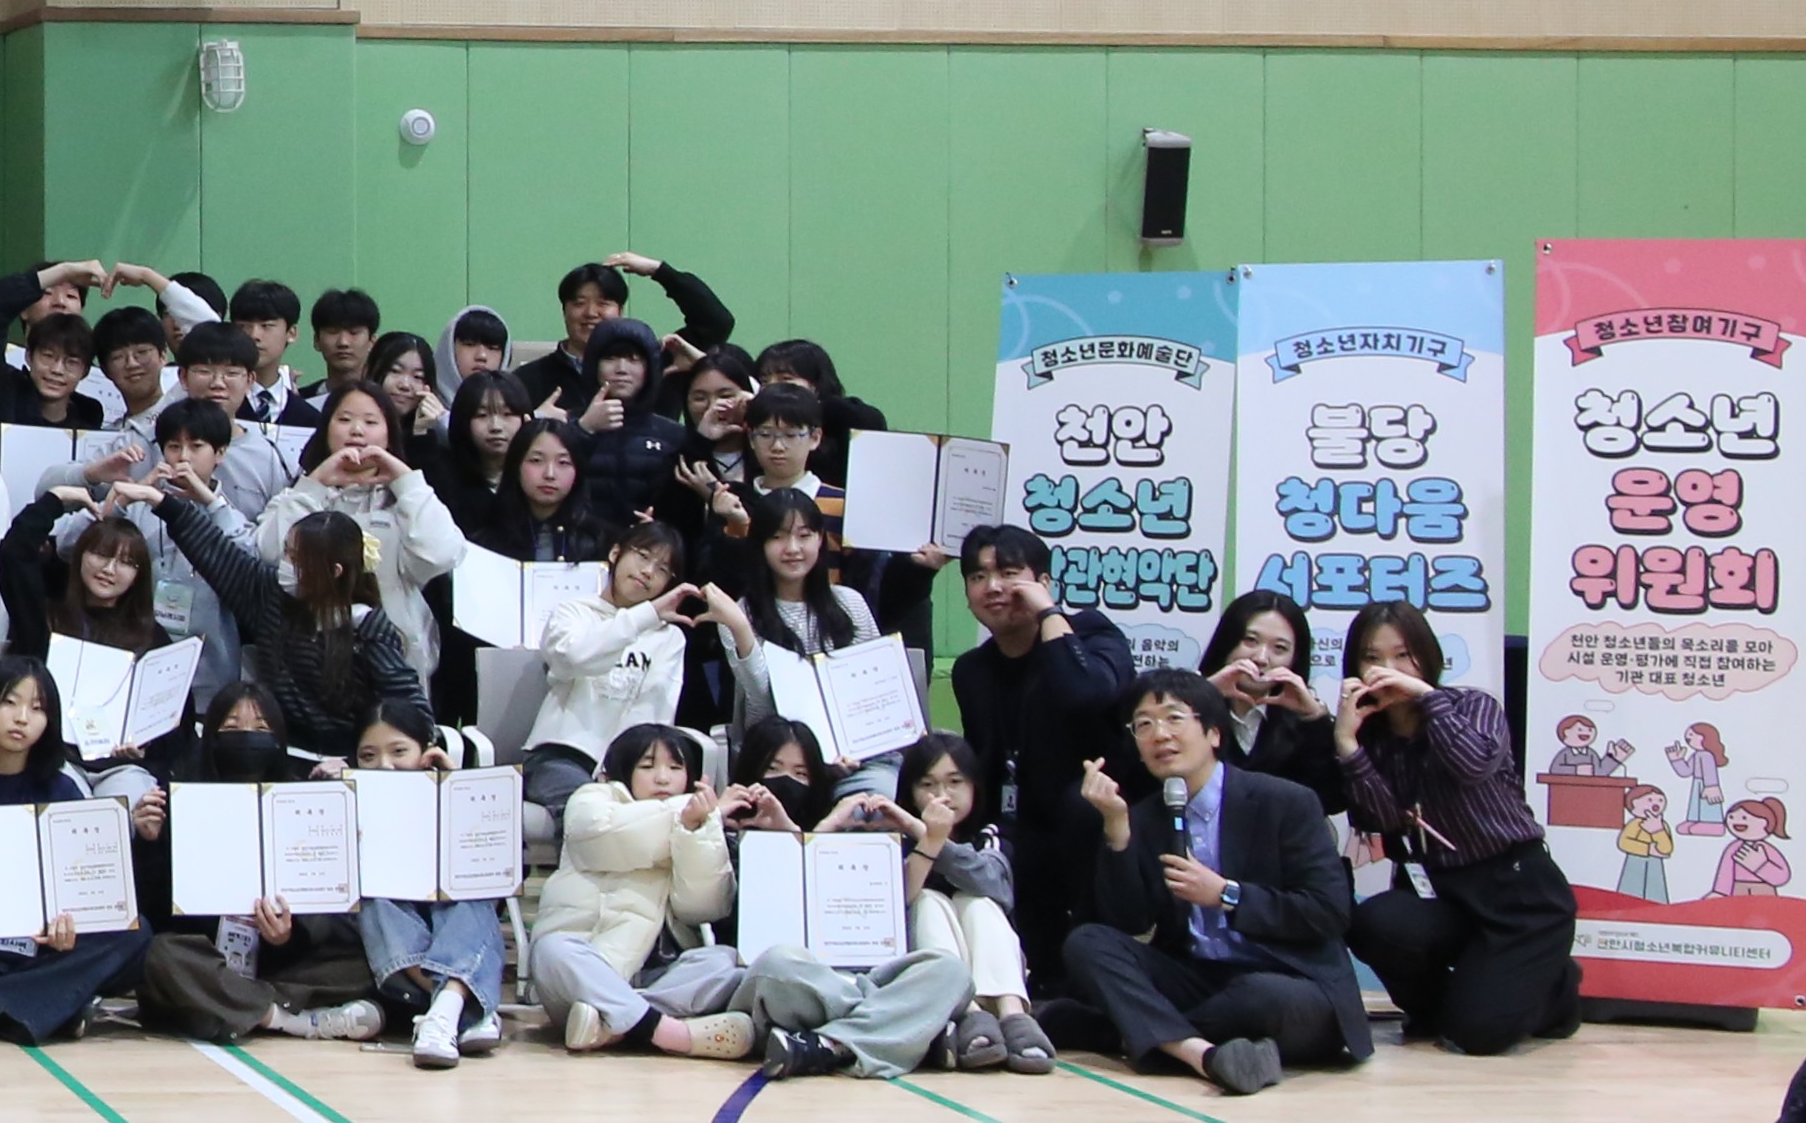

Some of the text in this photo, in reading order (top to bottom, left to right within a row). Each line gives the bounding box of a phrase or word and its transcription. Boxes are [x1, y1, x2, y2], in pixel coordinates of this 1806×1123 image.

[1040, 341, 1193, 368] 청소년문화예술단
[1293, 332, 1447, 358] 청소년자치기구
[1594, 314, 1762, 342] 청소년참여기구
[1054, 404, 1173, 467] 천안
[1306, 403, 1438, 469] 불당
[1574, 388, 1780, 460] 청소년
[1022, 473, 1193, 539] 청소년
[1276, 476, 1469, 543] 청다움
[1606, 467, 1743, 538] 운영
[1255, 550, 1491, 613] 서포터즈
[1570, 544, 1780, 615] 위원회
[1567, 652, 1595, 665] 시설
[1683, 655, 1711, 670] 직접
[1716, 656, 1776, 672] 참여하는
[1570, 634, 1773, 654] 천안 청소년들의 목소리를 모아
[1615, 670, 1726, 687] 기관 대표 청소년
